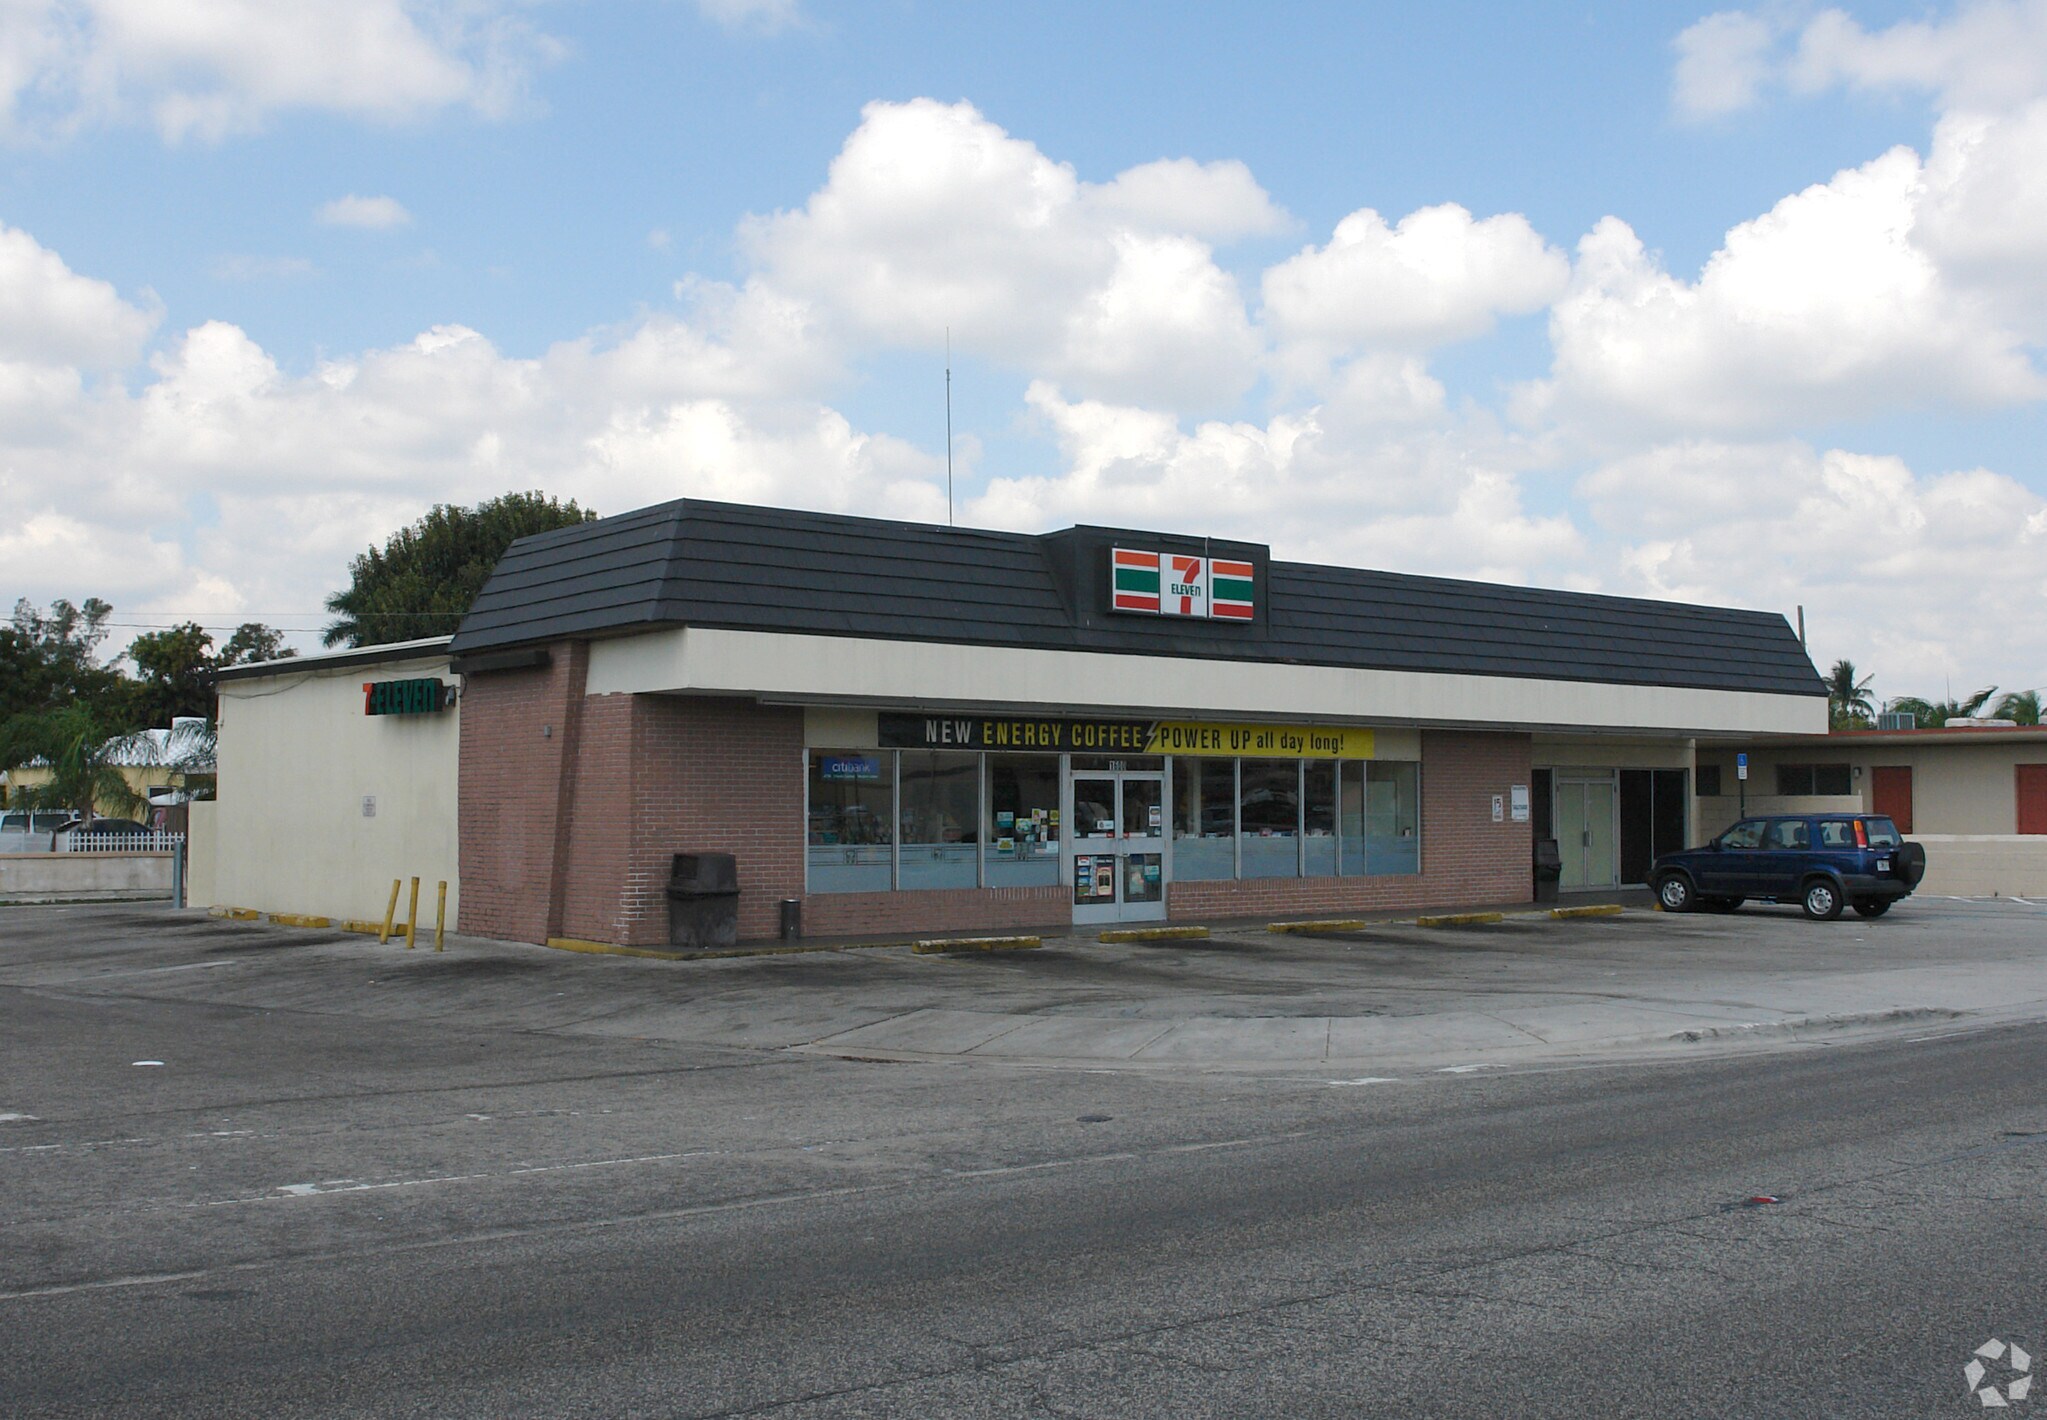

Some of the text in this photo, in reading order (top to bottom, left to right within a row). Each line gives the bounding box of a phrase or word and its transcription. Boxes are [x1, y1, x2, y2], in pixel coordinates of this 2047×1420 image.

[1173, 557, 1200, 614] 7
[925, 719, 1344, 754] NEW ENERGY COFFEE POWER UP all day long!
